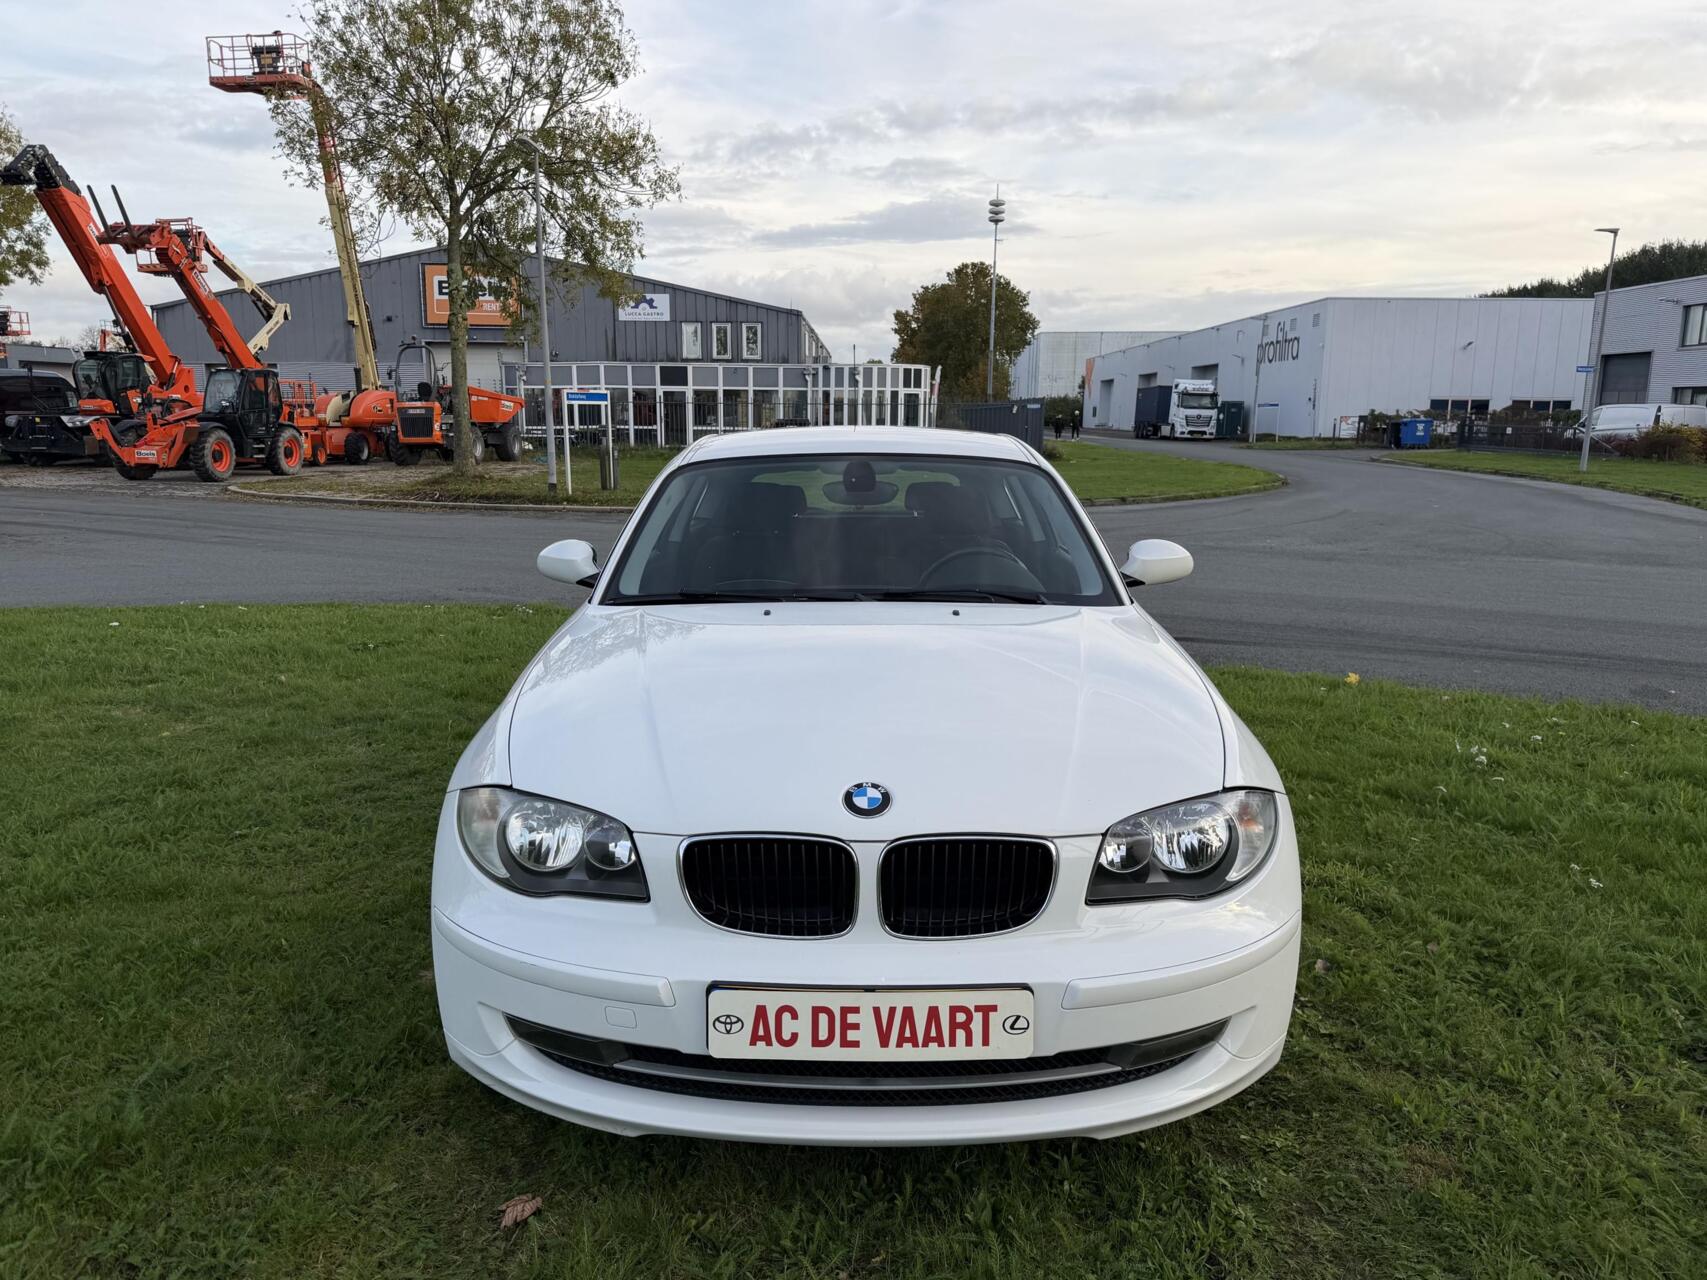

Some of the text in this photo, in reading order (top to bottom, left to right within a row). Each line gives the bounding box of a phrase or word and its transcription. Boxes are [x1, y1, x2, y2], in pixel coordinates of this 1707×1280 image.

[1256, 320, 1300, 374] profiltra
[849, 782, 887, 793] BMW
[749, 1004, 998, 1049] AC DE VAART
